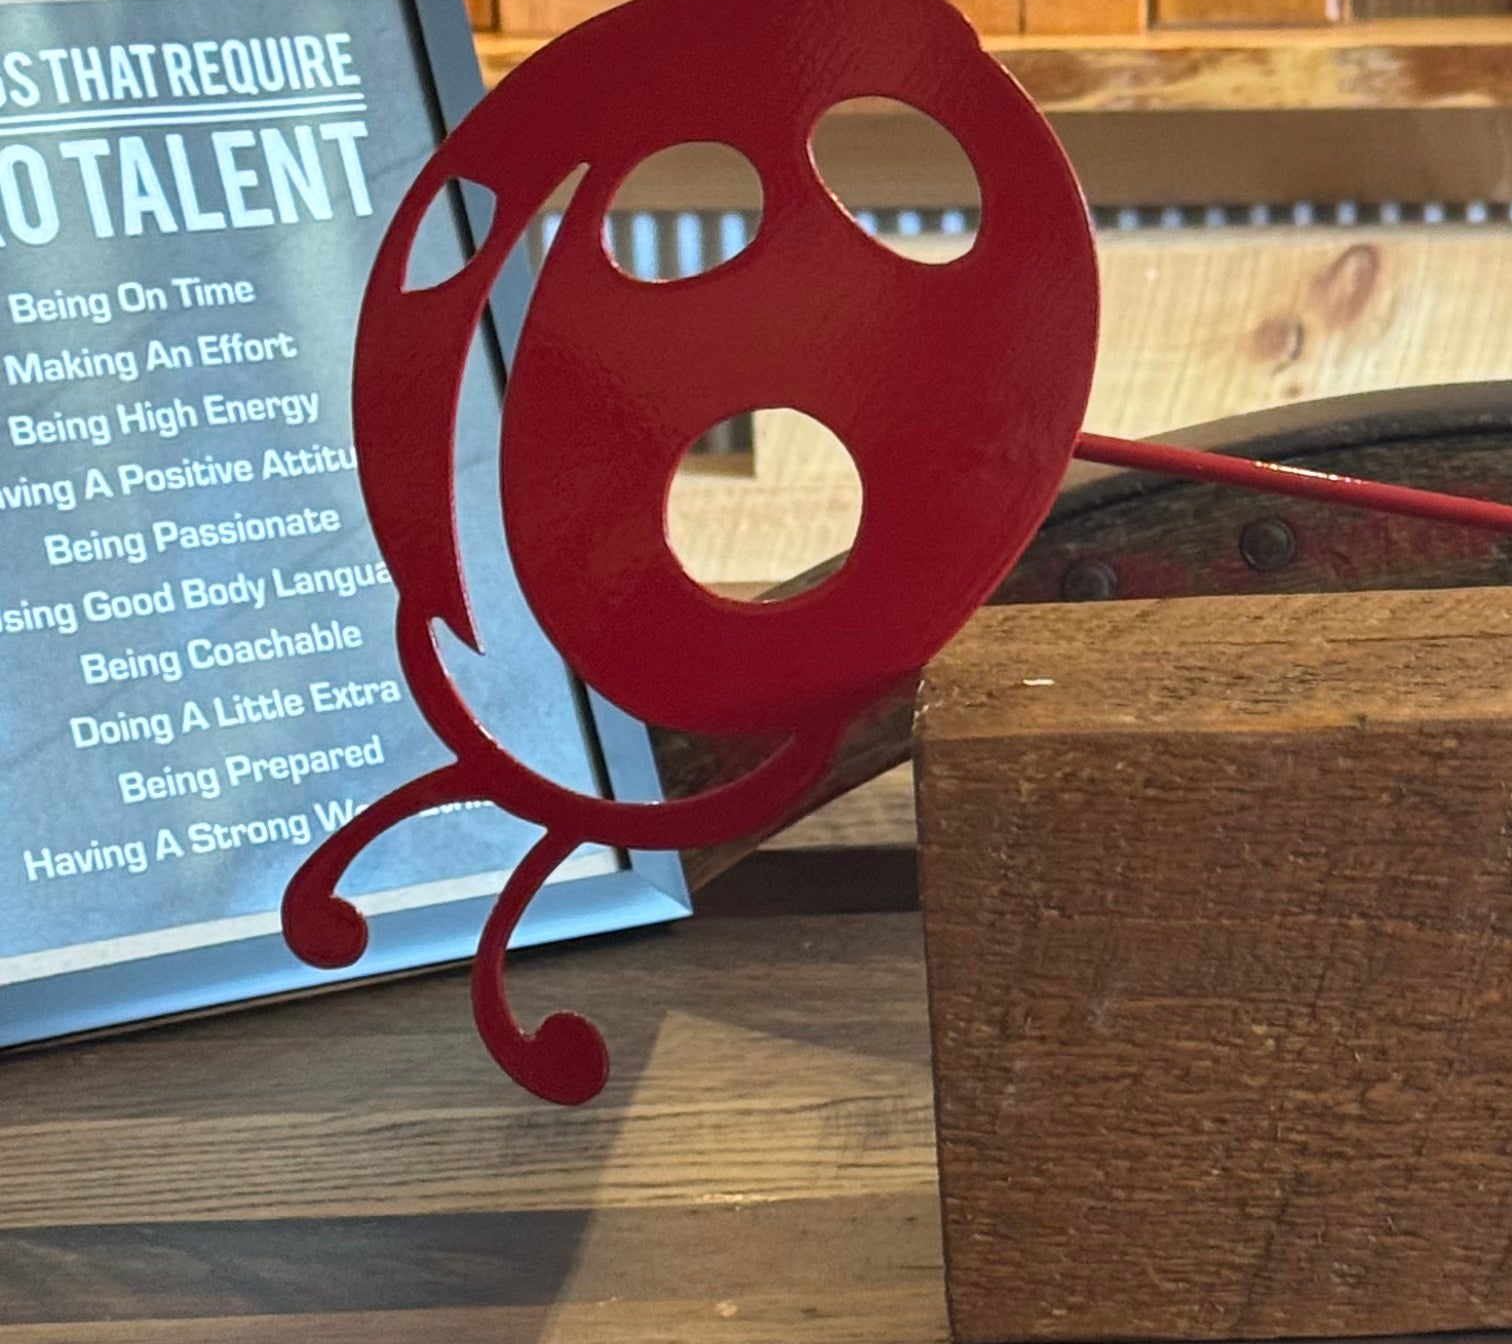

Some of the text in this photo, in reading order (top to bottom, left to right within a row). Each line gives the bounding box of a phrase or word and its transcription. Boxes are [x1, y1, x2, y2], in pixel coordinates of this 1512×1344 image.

[0, 32, 361, 108] S THAT REQUIRE
[0, 120, 373, 248] O TALENT
[8, 276, 256, 324] Being On Time
[3, 332, 298, 386] Making An Effort
[8, 392, 319, 446] Being High Energy
[0, 476, 76, 511] ving
[84, 468, 113, 500] A
[118, 454, 254, 496] Positive
[44, 508, 342, 566] Being Passionate
[0, 599, 79, 635] sing
[83, 582, 175, 622] Good
[181, 573, 265, 609] Body
[80, 620, 363, 686] Being Coachable
[70, 677, 401, 749] Doing A Little Extra
[118, 733, 385, 806] Being Prepared
[24, 840, 148, 882] Having
[156, 828, 184, 861] A
[188, 811, 311, 854] Strong
